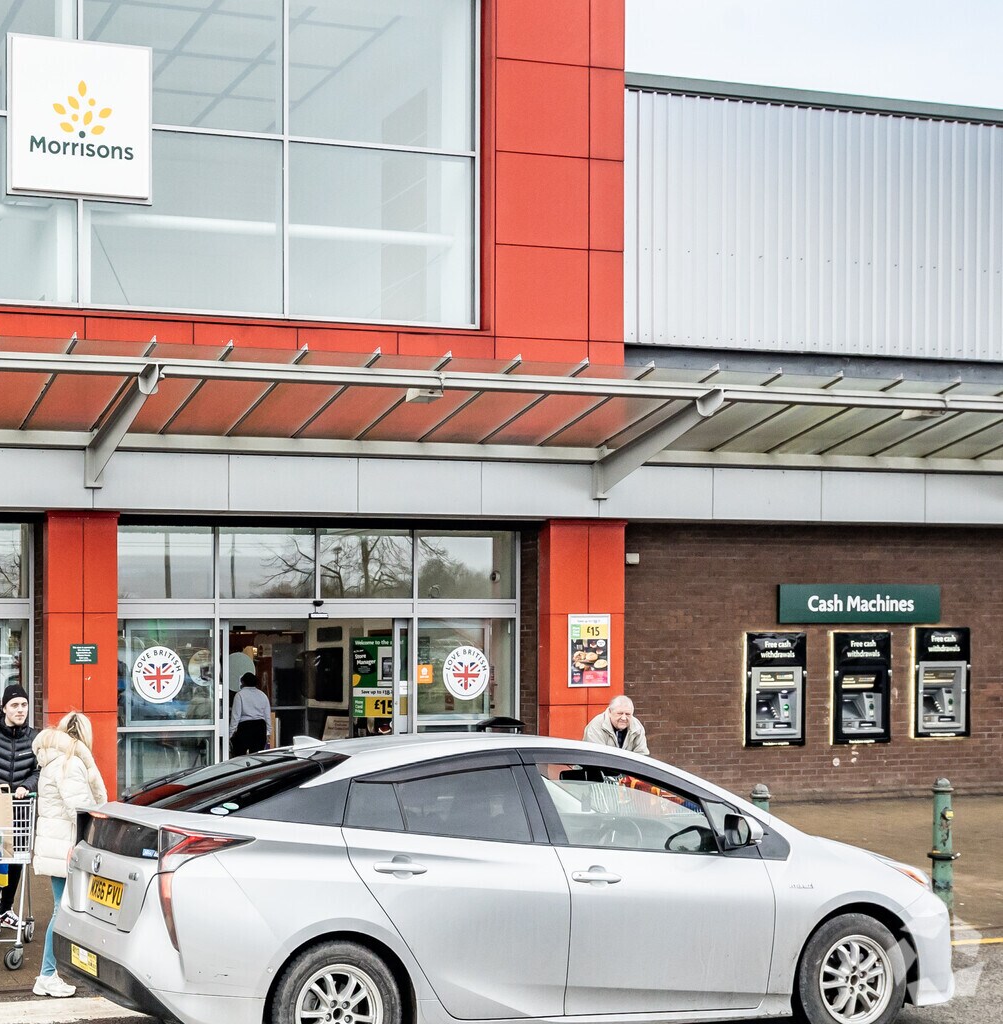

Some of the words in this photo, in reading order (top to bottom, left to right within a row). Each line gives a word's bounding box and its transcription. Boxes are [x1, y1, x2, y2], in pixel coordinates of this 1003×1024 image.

[29, 131, 134, 160] Morrisons
[807, 594, 844, 612] Cash
[847, 594, 915, 612] Machines
[587, 626, 600, 636] £15
[764, 640, 778, 648] Free
[778, 640, 792, 648] cash
[850, 640, 862, 648] Free
[864, 640, 876, 648] cash
[931, 635, 942, 643] Free
[944, 635, 956, 643] cash
[928, 644, 960, 653] withdrawals
[760, 650, 795, 658] withdrawals
[847, 650, 880, 658] withdrawals
[135, 652, 152, 674] LOVE
[154, 650, 182, 672] BRITISH
[446, 651, 460, 671] LOVE
[462, 648, 487, 671] BRITISH
[374, 700, 392, 714] £15
[105, 884, 123, 906] PVU
